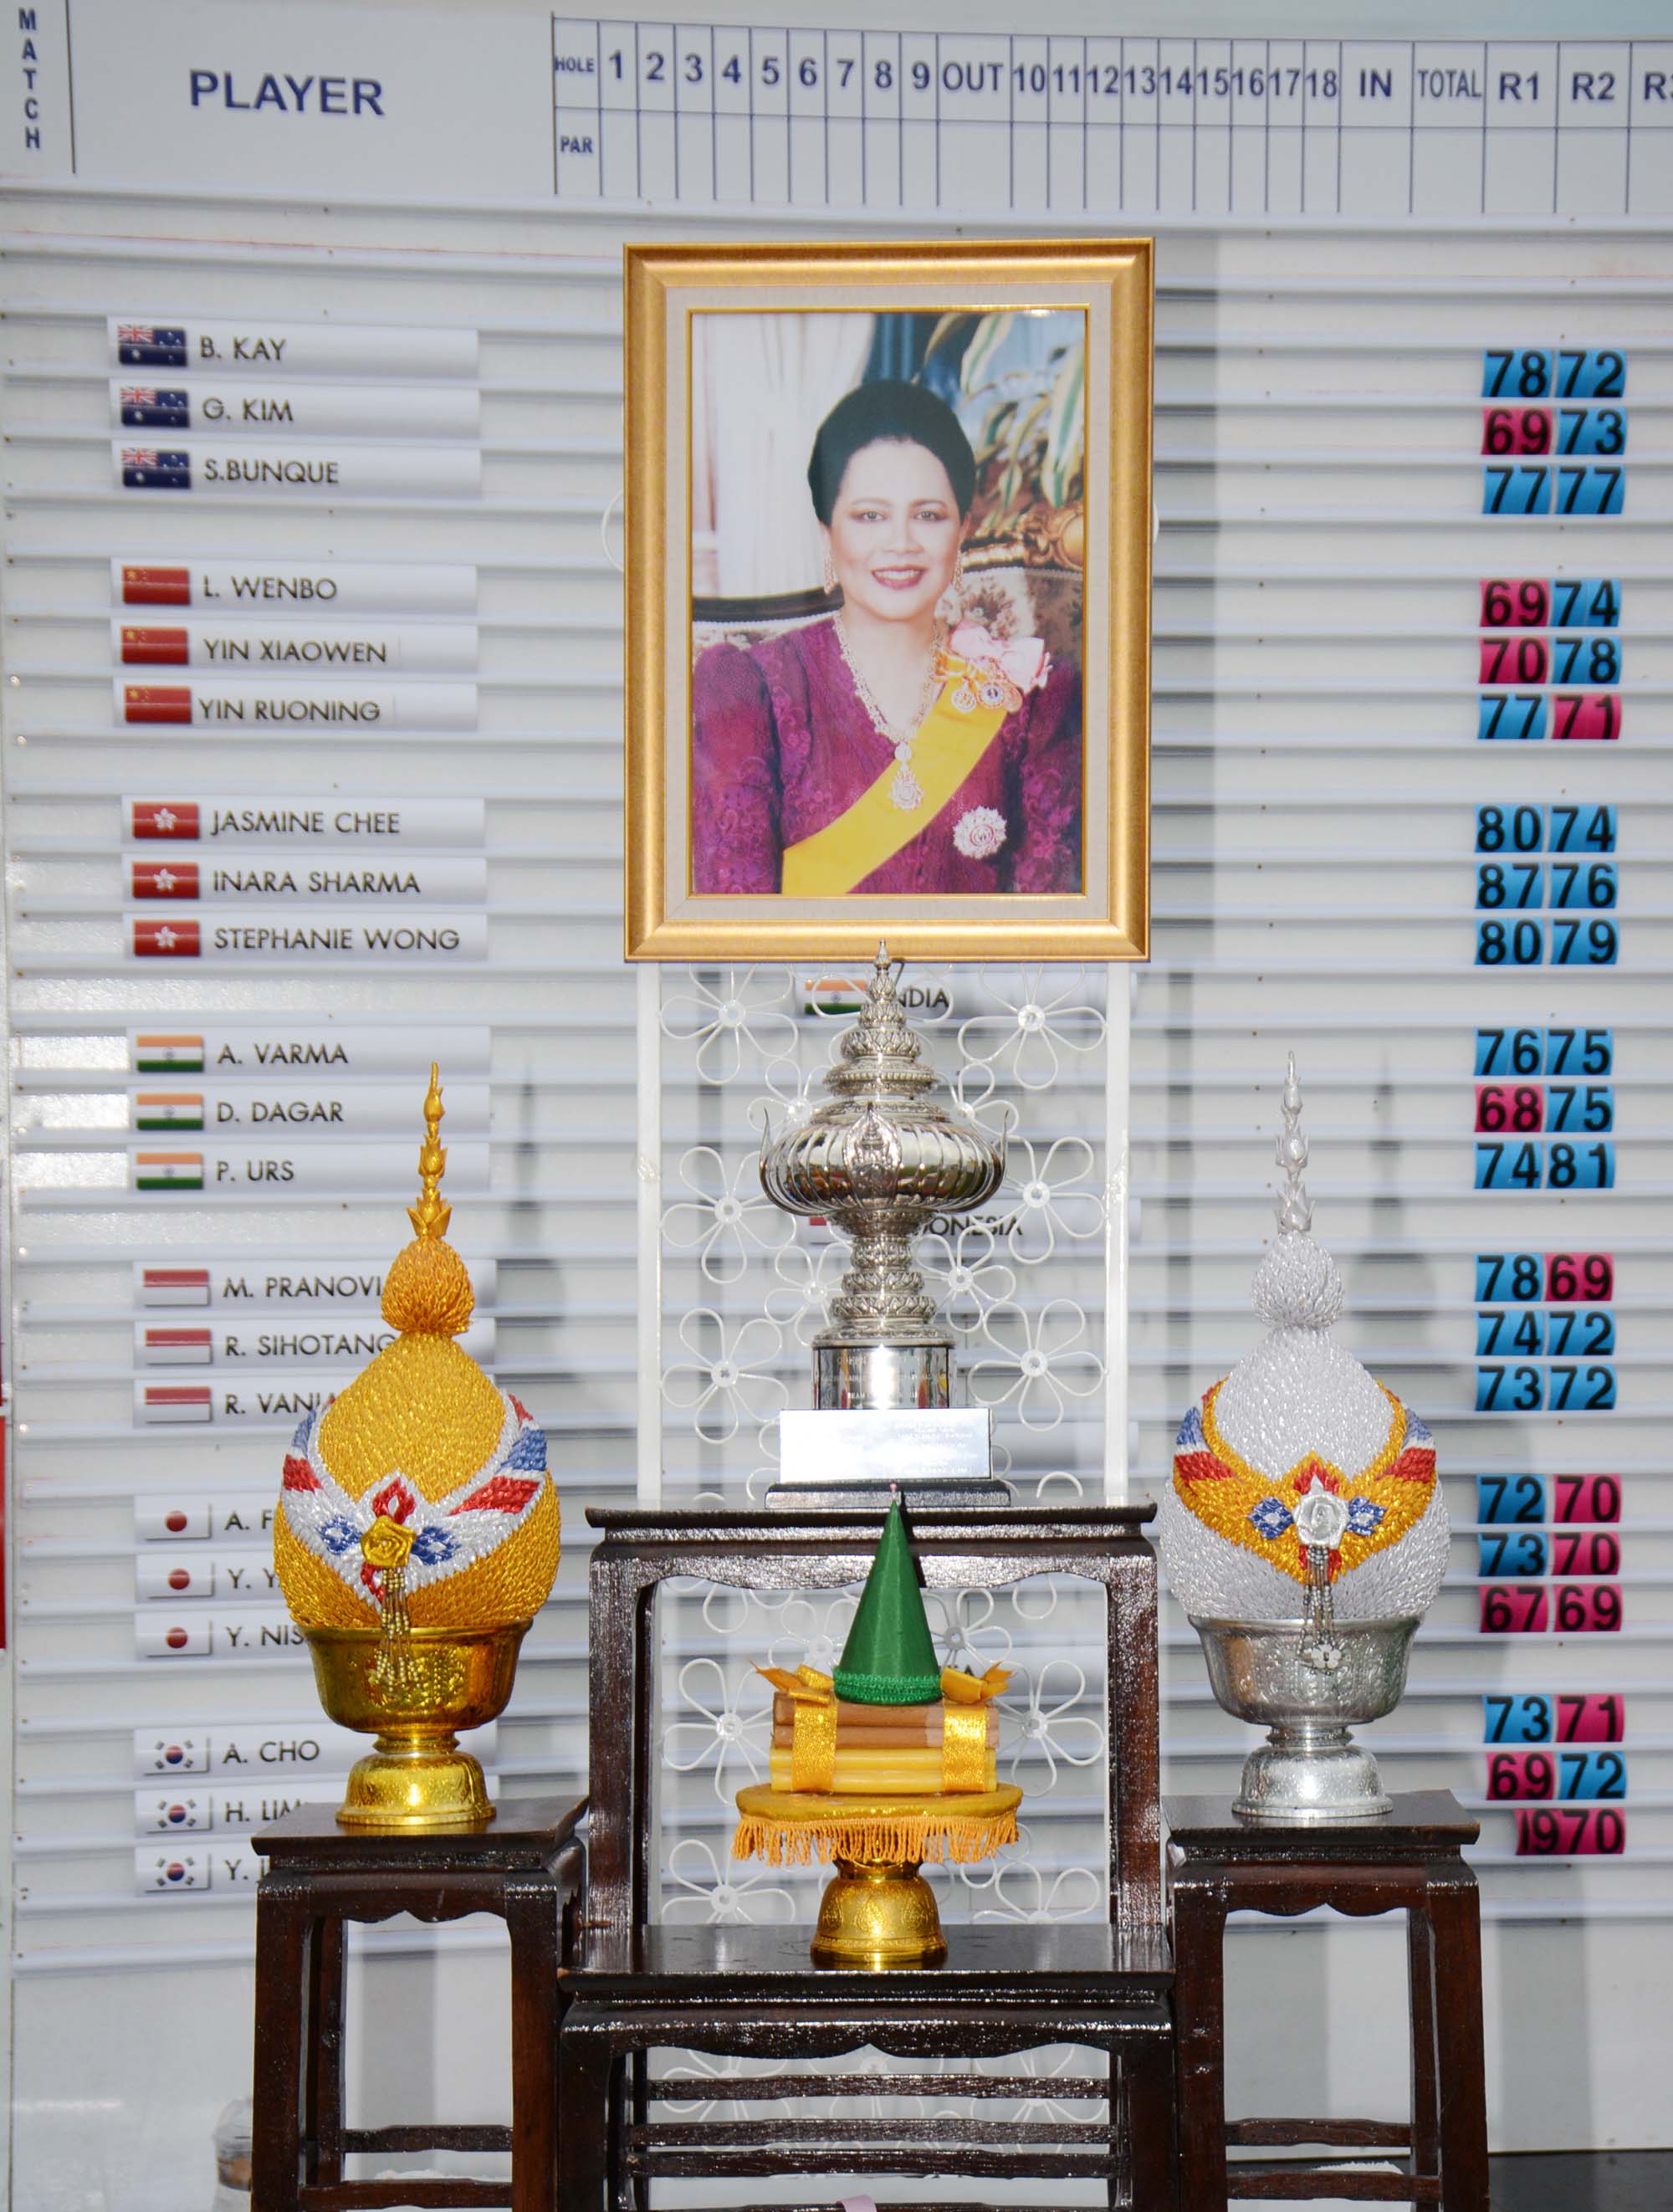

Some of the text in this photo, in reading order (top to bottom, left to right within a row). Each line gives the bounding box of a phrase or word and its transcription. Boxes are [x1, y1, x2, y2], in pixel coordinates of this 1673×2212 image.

[18, 8, 40, 150] MATCH
[189, 69, 384, 115] PLAYER
[555, 49, 1673, 101] HOLE 1 2 3 4 5 6 7 8 9 OUT 10 11 12 13 14 15 16 17 18 IN TOTAL R1 R2 R
[560, 136, 593, 154] PAR
[200, 336, 285, 361] B. KAY
[1486, 350, 1623, 397] 78 72
[202, 397, 294, 422] G. KIM
[1486, 408, 1624, 454] 69 73
[204, 458, 339, 484] S.BUNQUE
[1486, 466, 1621, 514] 77 77
[203, 576, 337, 601] L. WENBO
[1485, 581, 1618, 626] 69 74
[204, 639, 386, 663] YIN XIAOWEN
[1483, 637, 1616, 684] 70 78
[199, 700, 381, 722] YIN RUONING
[1481, 694, 1613, 739] 77 71
[209, 811, 401, 837] JASMINE CHEE
[1478, 806, 1613, 852] 80 74
[213, 872, 422, 894] INARA SHARMA
[1478, 863, 1614, 908] 87 76
[214, 929, 460, 950] STEPHANIE WONG
[1480, 919, 1615, 965] 80 79
[898, 986, 949, 1009] DIA
[217, 1043, 349, 1065] A. VARMA
[1477, 1029, 1609, 1075] 76 75
[216, 1102, 344, 1124] D. DAGAR
[1479, 1086, 1610, 1131] 68 75
[216, 1160, 294, 1182] P. URS
[1477, 1144, 1607, 1188] 74 81
[223, 1278, 254, 1298] M.
[1478, 1255, 1610, 1301] 78 69
[225, 1336, 247, 1357] R.
[1478, 1312, 1612, 1355] 74 72
[225, 1394, 246, 1415] R.
[1478, 1366, 1613, 1410] 73 72
[1481, 1476, 1618, 1523] 72 70
[223, 1513, 250, 1531] A.
[1481, 1534, 1615, 1576] 73 70
[228, 1569, 252, 1590] Y.
[1485, 1586, 1619, 1631] 67 69
[227, 1626, 250, 1647] Y.
[1487, 1696, 1616, 1742] 73 71
[222, 1740, 320, 1764] A. CHO
[1492, 1752, 1623, 1800] 69 72
[224, 1802, 251, 1824] H.
[225, 1859, 248, 1882] Y.
